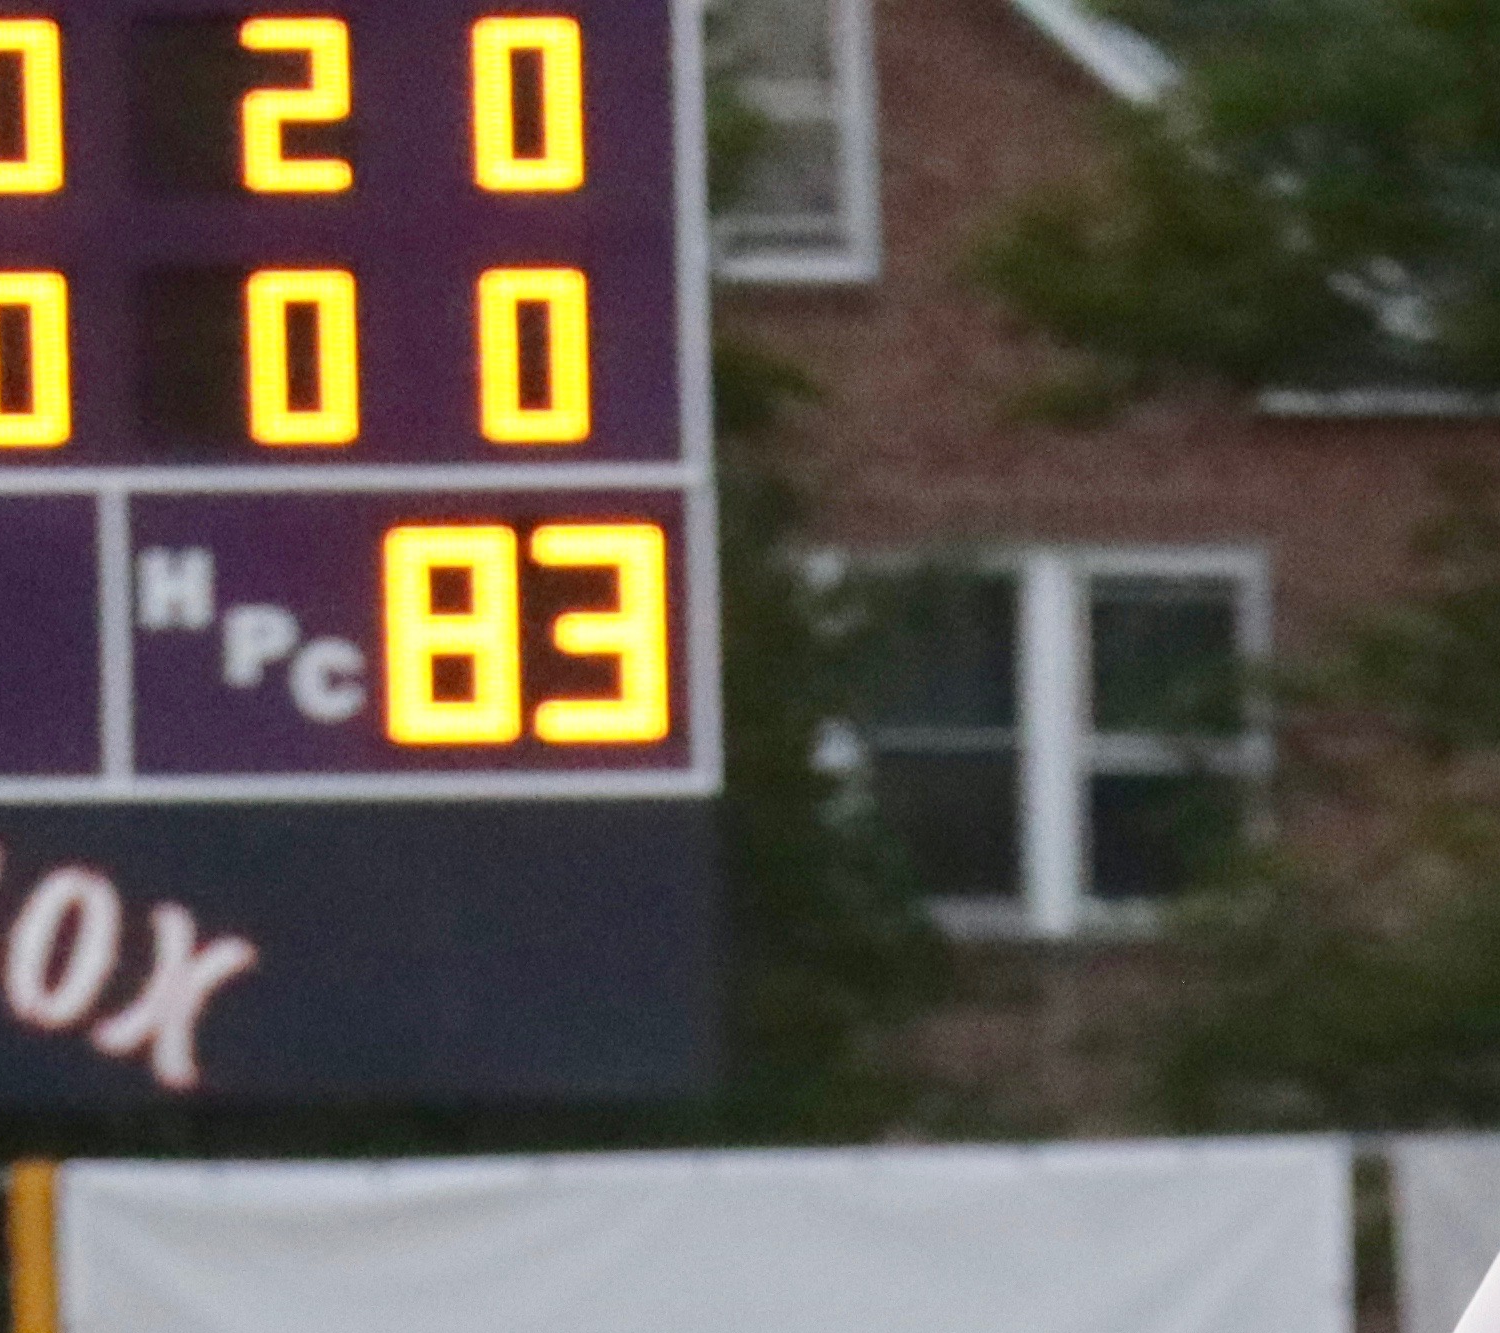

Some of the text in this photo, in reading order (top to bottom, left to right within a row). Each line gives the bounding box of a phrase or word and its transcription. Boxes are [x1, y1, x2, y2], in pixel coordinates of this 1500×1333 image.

[241, 17, 352, 192] 2
[471, 16, 584, 191] 0
[246, 269, 359, 445] 0
[478, 268, 590, 443] 0
[383, 522, 669, 746] 83
